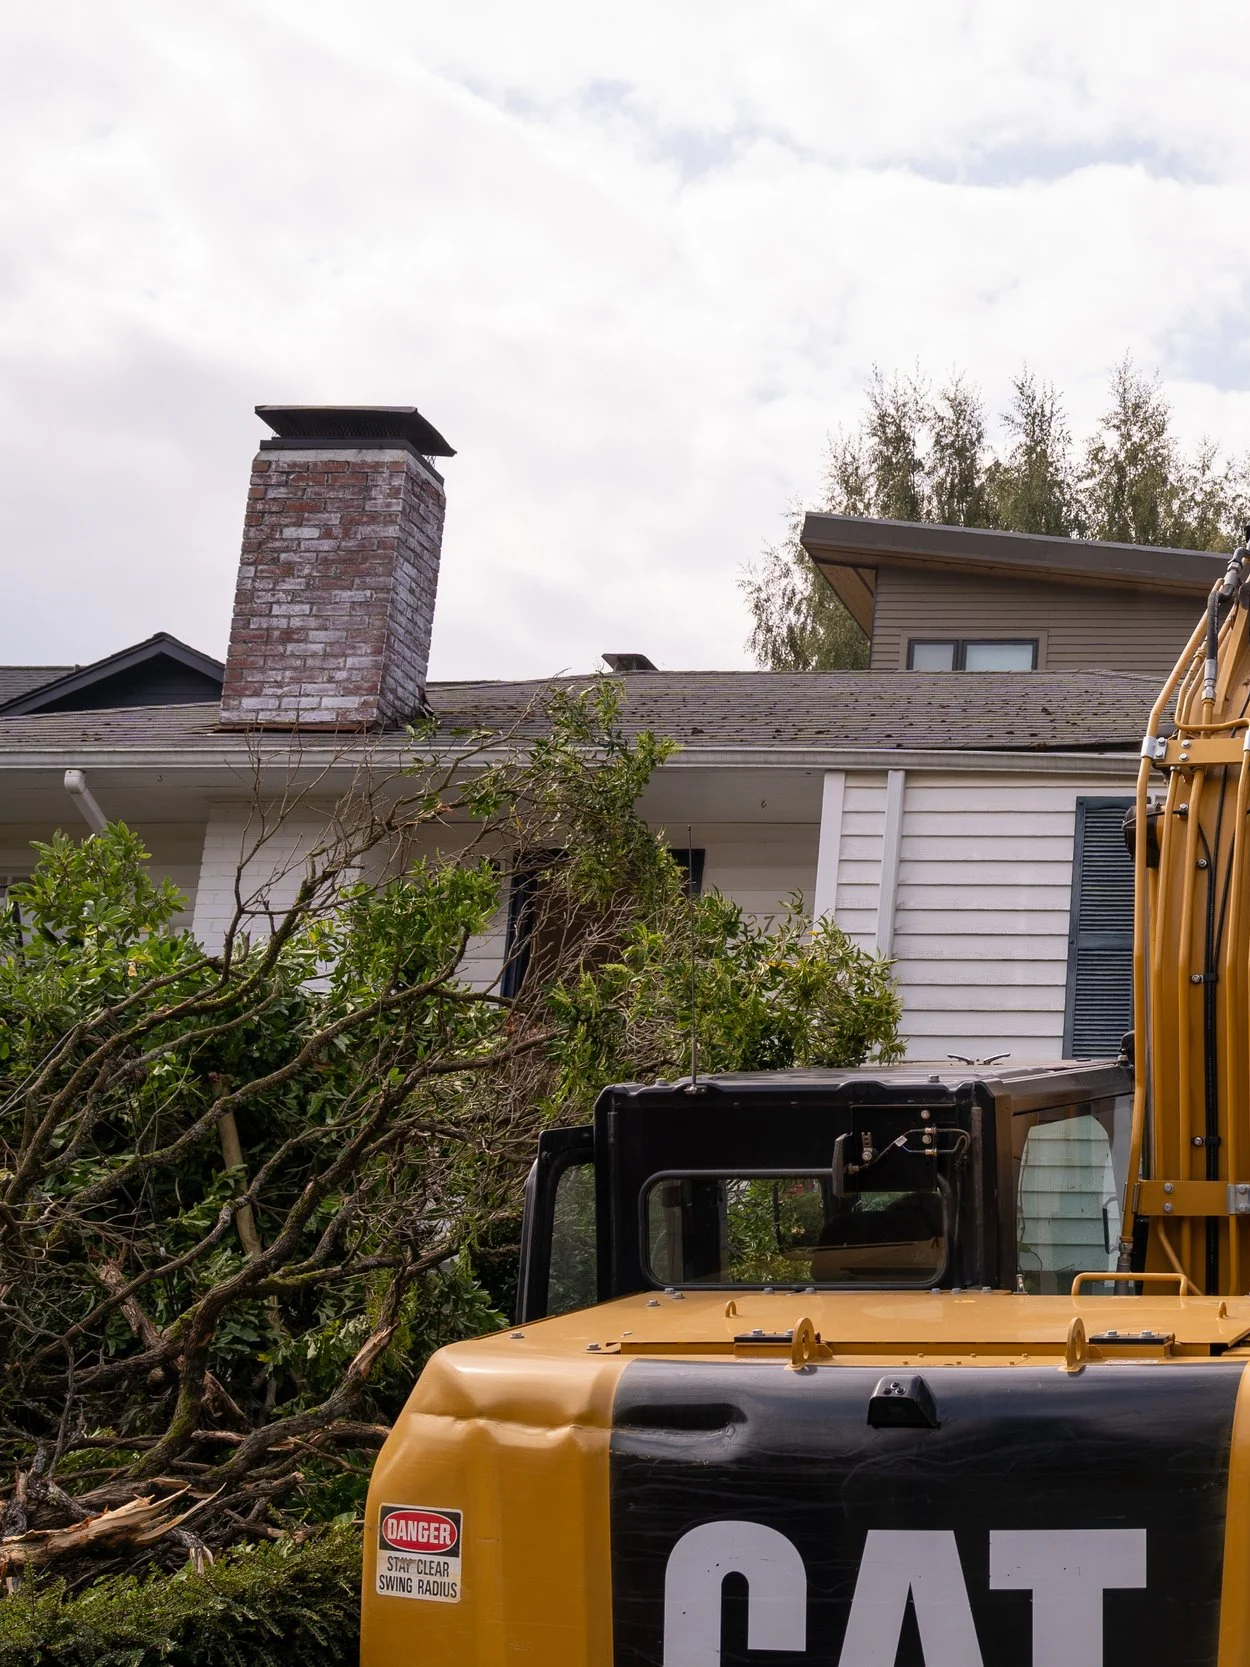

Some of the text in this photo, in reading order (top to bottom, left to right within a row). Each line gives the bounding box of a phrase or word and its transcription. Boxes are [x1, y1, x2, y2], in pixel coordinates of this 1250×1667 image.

[387, 1518, 452, 1545] DANGER
[387, 1556, 450, 1578] STAY CLEAR
[379, 1574, 457, 1598] SWING RADIUS
[663, 1520, 1147, 1667] CAT
